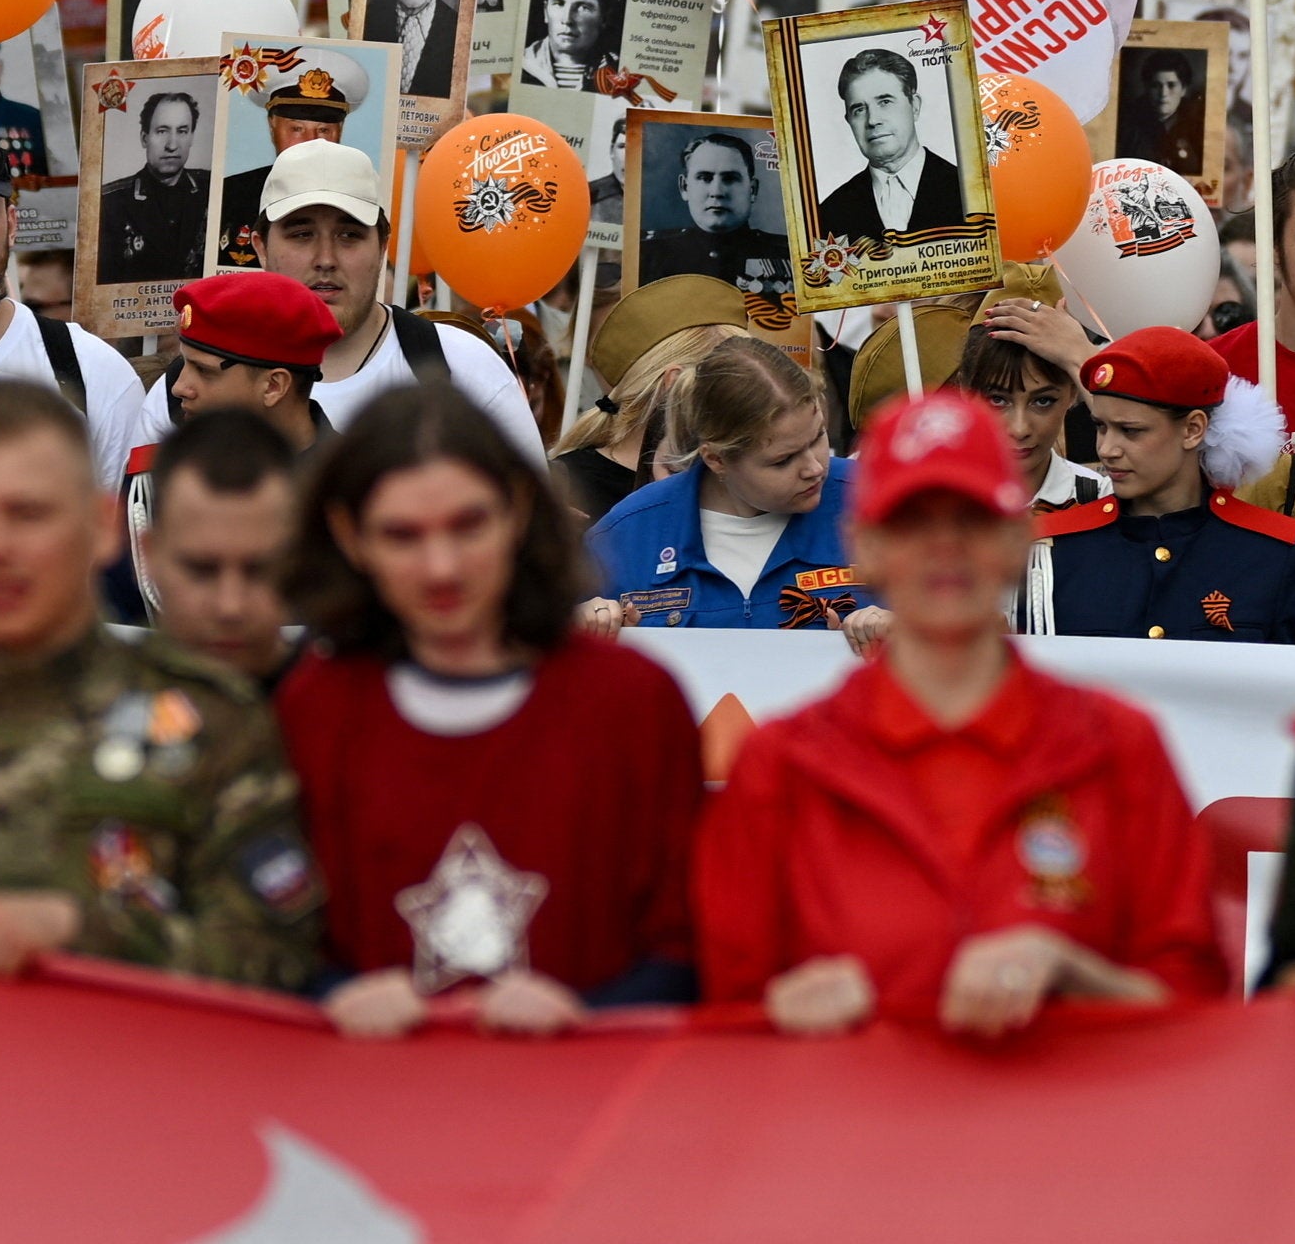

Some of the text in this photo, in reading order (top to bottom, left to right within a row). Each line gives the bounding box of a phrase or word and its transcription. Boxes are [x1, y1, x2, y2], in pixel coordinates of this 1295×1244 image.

[640, 9, 690, 24] ефрейтор,
[651, 22, 677, 32] сапер
[645, 45, 678, 56] дивизия
[651, 39, 695, 50] отдельная
[635, 53, 683, 65] Инженерная
[921, 55, 954, 68] ПОЛК
[638, 63, 660, 73] рота
[401, 111, 441, 123] ПЕТРОВИЧ
[468, 134, 548, 177] Победы
[918, 239, 988, 259] КОПЕЙКИН
[859, 255, 990, 282] Григорий Антонович
[852, 280, 890, 291] Сержант,
[891, 274, 931, 286] командир
[949, 267, 992, 278] отделения
[921, 278, 965, 289] батальона
[113, 296, 173, 308] ПЕТР АНТО
[115, 311, 157, 321] 04.05.1924
[145, 320, 176, 328] Капитан
